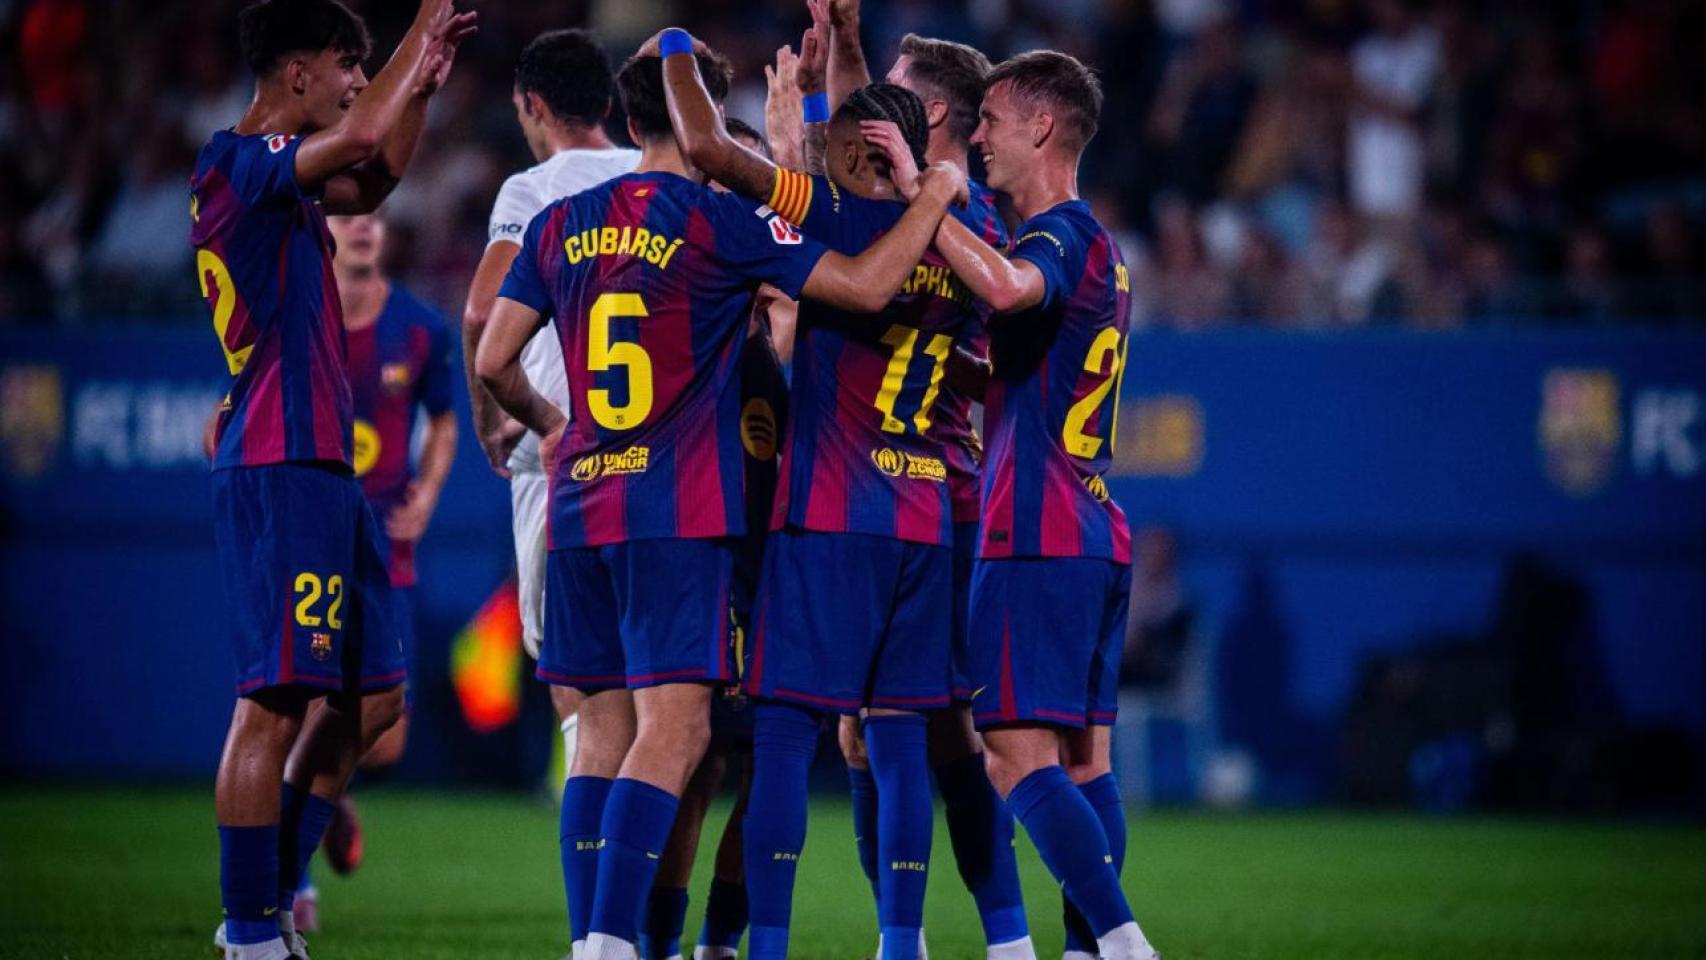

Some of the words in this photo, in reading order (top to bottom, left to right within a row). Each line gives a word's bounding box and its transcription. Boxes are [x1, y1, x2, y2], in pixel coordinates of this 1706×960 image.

[564, 226, 686, 271] CUBARSÍ
[587, 292, 654, 432] 5
[873, 323, 954, 436] 11
[1063, 326, 1130, 460] 2
[293, 572, 344, 631] 22
